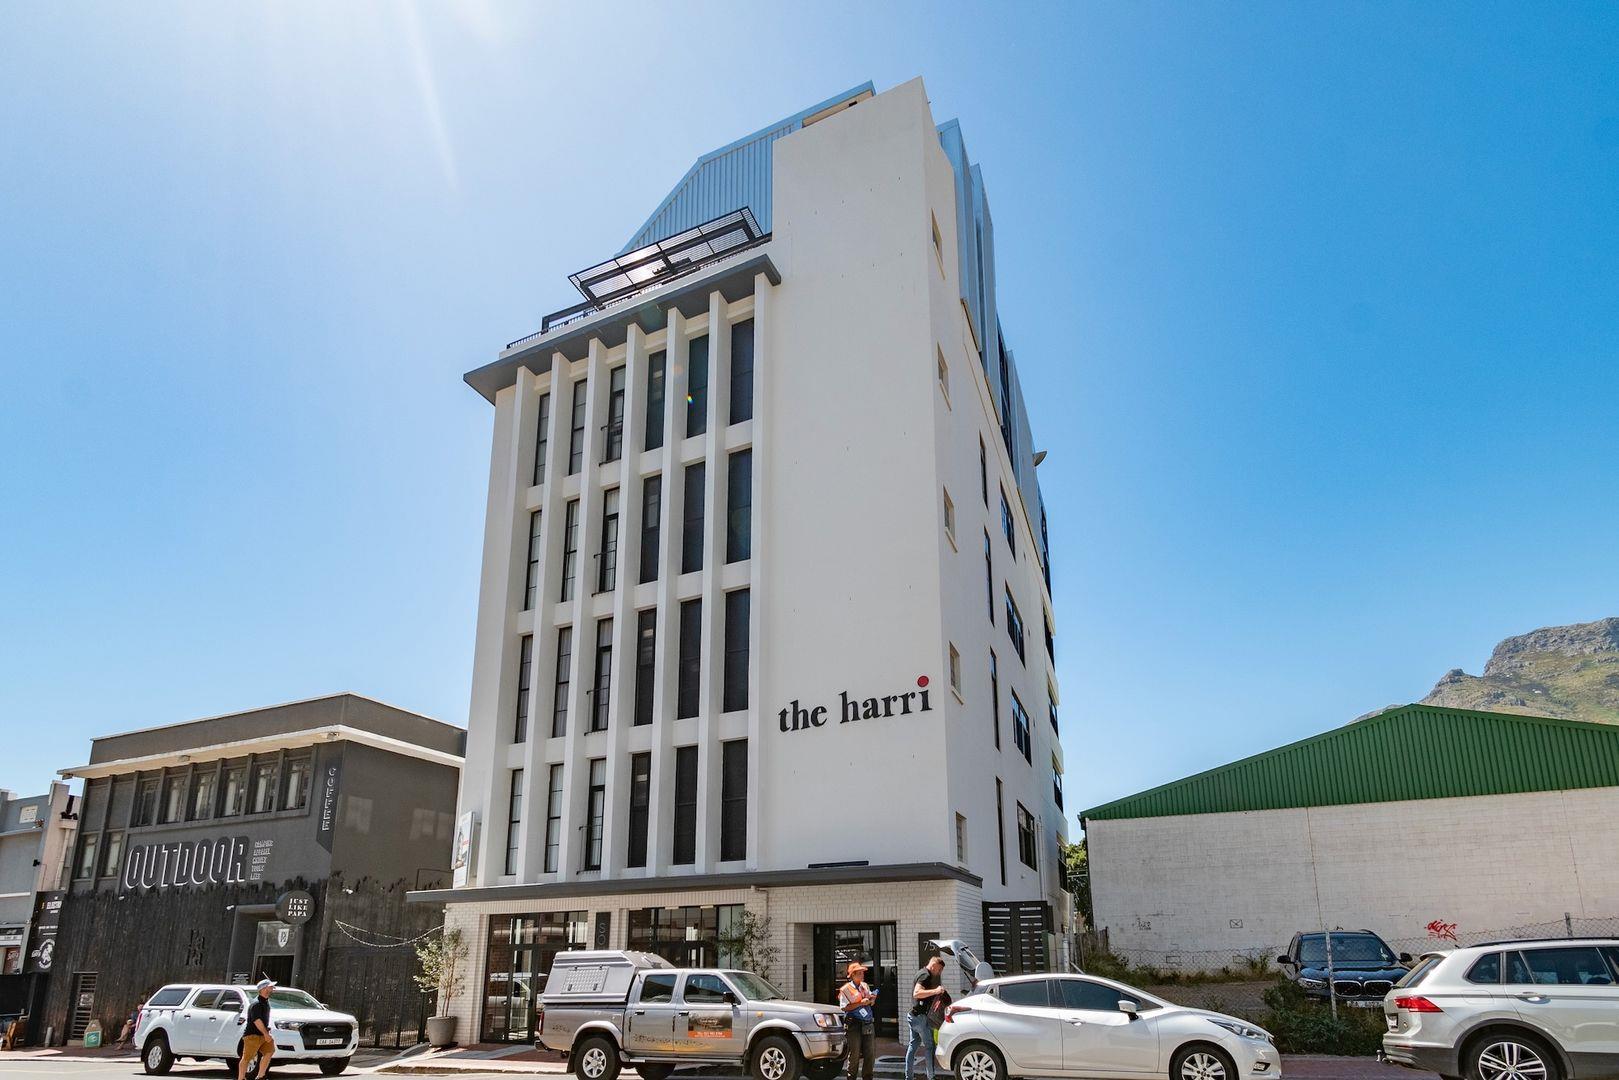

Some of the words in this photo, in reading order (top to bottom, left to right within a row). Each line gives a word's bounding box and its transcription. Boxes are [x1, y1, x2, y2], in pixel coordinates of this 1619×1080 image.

[778, 699, 828, 733] the
[838, 675, 933, 724] harri
[322, 767, 337, 831] COFFEE
[125, 835, 250, 889] OUTDOOR
[923, 940, 936, 951] 75
